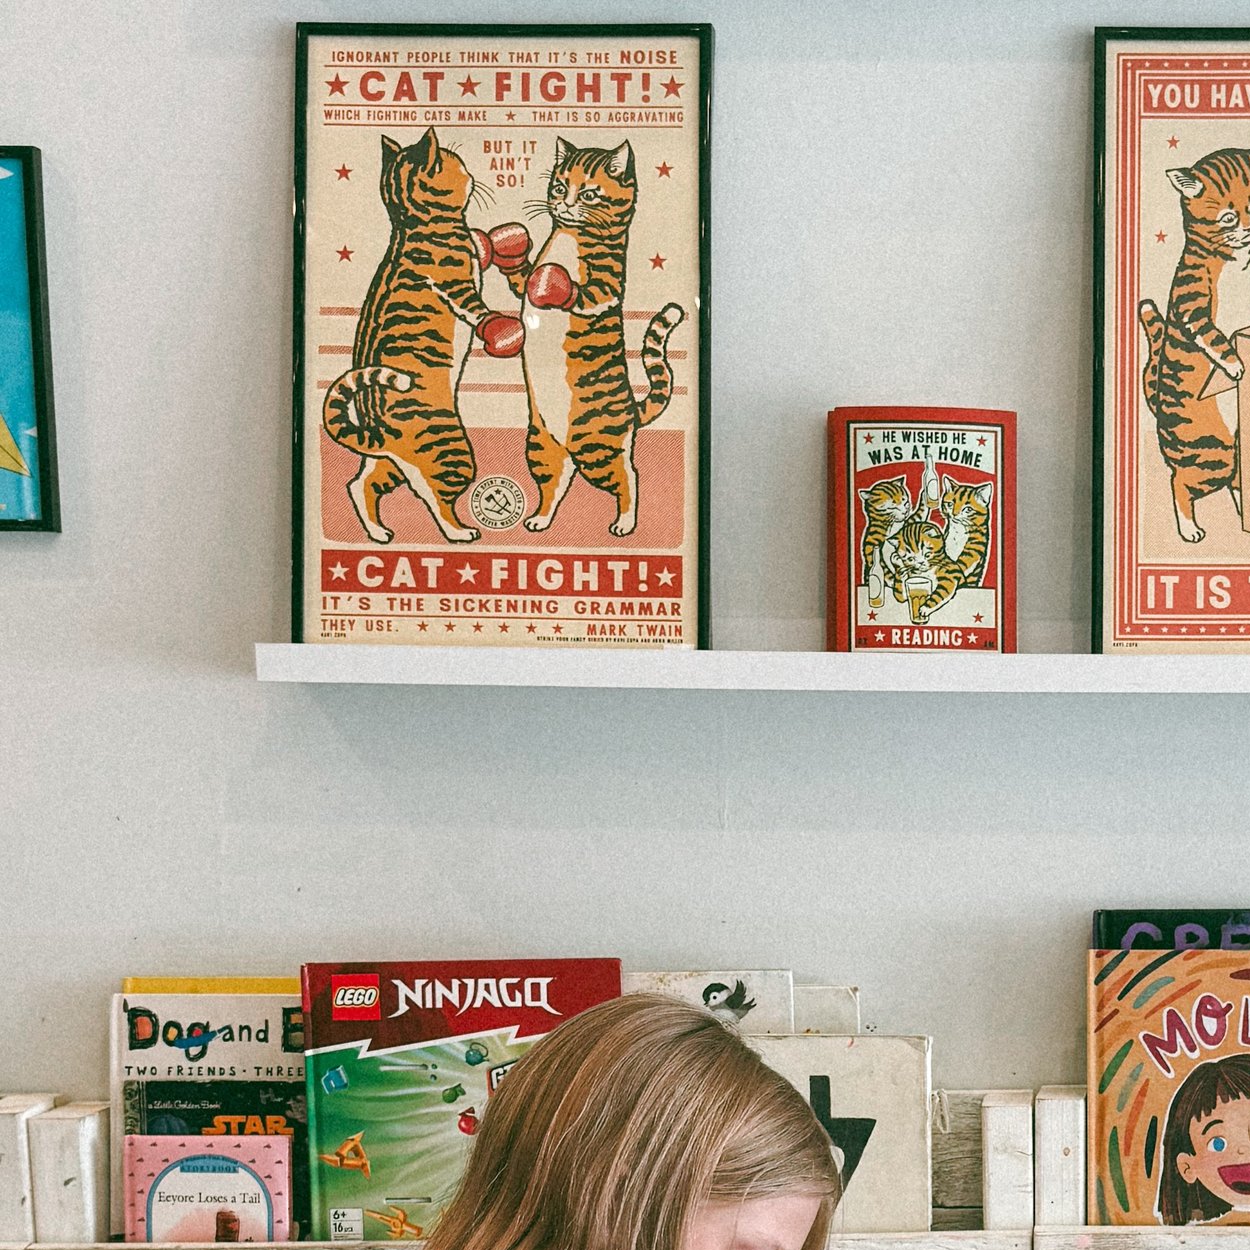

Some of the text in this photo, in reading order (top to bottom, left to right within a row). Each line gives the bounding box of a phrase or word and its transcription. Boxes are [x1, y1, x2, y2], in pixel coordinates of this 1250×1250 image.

[332, 50, 677, 64] IGNORANT PEOPLE THINK THAT IT'S THE NOISE
[359, 71, 651, 103] CAT FIGHT!
[1148, 83, 1200, 108] YOU
[324, 110, 684, 123] WHICH FIGHTING CATS MAKE THAT IS SO AGGRAVATING
[483, 141, 537, 154] BUT IT
[490, 158, 531, 170] AIN'T
[496, 174, 525, 187] SO!
[883, 431, 967, 445] HE WISHED HE
[868, 445, 983, 468] WAS AT HOME
[357, 556, 648, 592] CAT FIGHT!
[1147, 575, 1179, 609] IT
[1195, 575, 1231, 609] IS
[322, 596, 681, 616] IT'S THE SICKENING GRAMMAR
[321, 619, 682, 637] THEY USE. MARK TWAIN
[892, 628, 963, 646] READING
[335, 977, 563, 1019] LEGO NINJAGO
[127, 1006, 210, 1062] Dog
[219, 1018, 269, 1043] and
[125, 1066, 304, 1077] TWO FRIENDS THREE
[202, 1114, 294, 1135] STAR
[158, 1191, 194, 1205] Eeyore
[199, 1192, 228, 1203] Loses
[240, 1193, 261, 1203] Tail
[333, 1210, 346, 1220] 6+
[333, 1222, 343, 1232] 16
